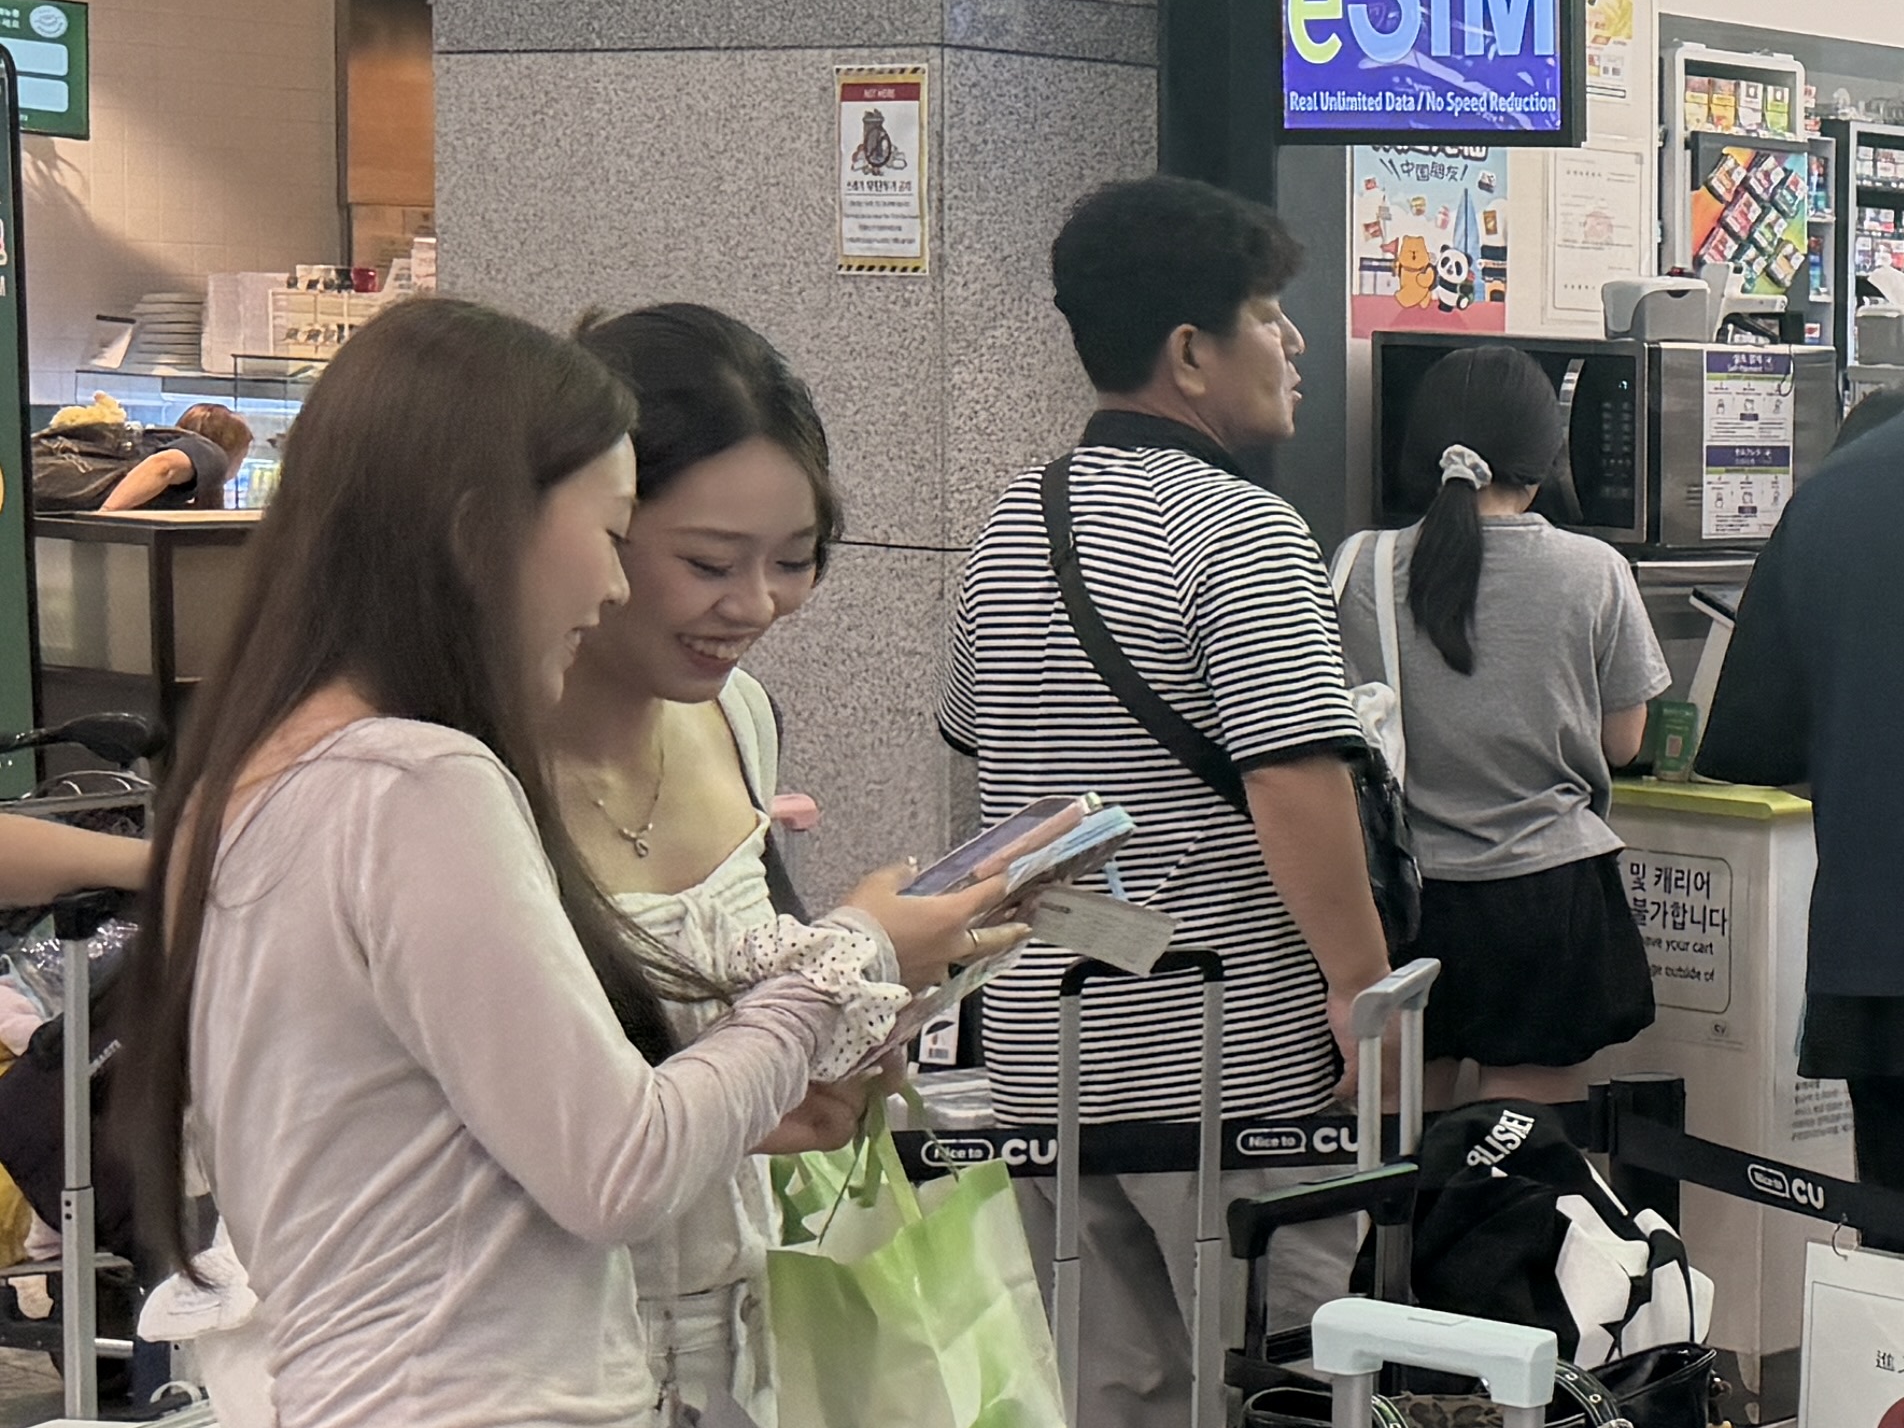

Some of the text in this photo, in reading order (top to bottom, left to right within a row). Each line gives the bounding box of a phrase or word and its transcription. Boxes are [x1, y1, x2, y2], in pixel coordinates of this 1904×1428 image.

[1290, 91, 1556, 116] Real Unlimited Data No Speed Reduction
[1629, 861, 1711, 900] 및 캐리어
[1631, 896, 1728, 936] 불가합니다
[1665, 939, 1714, 955] your cart
[967, 1145, 983, 1160] to
[1001, 1138, 1058, 1165] CU
[1248, 1127, 1358, 1152] Nice to CU
[1792, 1179, 1825, 1210] CU
